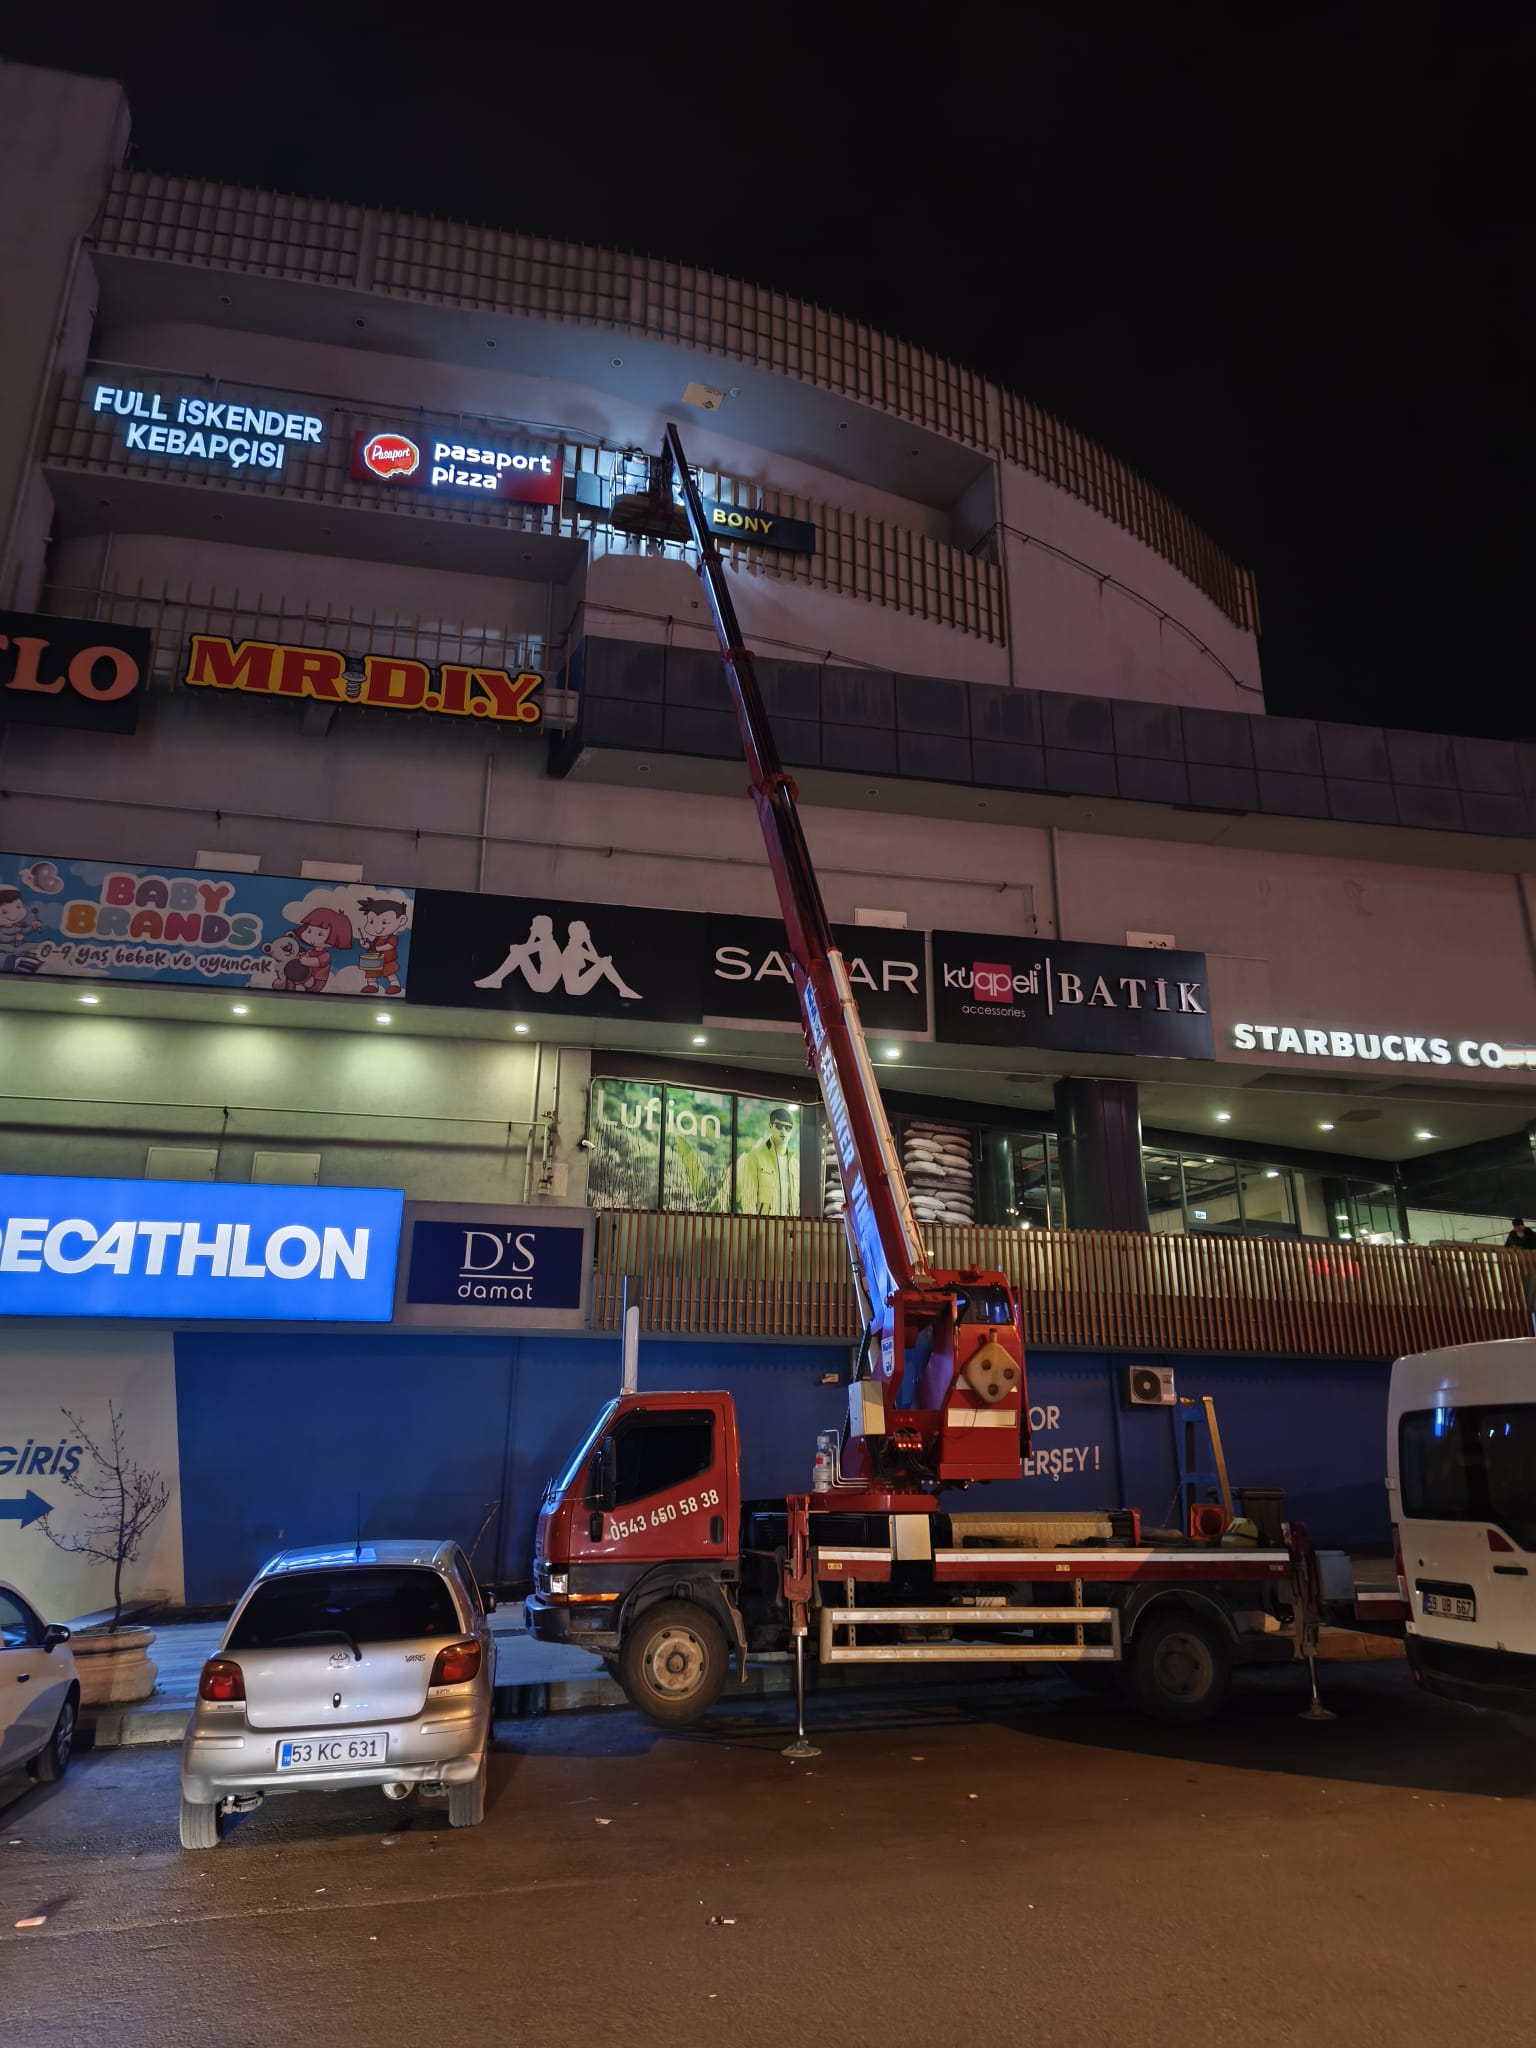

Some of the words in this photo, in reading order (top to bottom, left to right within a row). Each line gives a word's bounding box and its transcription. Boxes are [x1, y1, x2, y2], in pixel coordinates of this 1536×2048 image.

[93, 385, 168, 422] FULL
[176, 397, 324, 444] İSKENDER
[125, 422, 286, 470] KEBAPÇISI
[371, 443, 412, 463] Pasaport
[433, 442, 553, 474] pasaport
[431, 463, 498, 490] pizza
[712, 507, 774, 535] BONY
[103, 873, 231, 915] BABY
[63, 902, 259, 947] BRANDS
[41, 943, 73, 960] 0-9
[75, 947, 109, 966] yaş
[173, 952, 192, 966] ve
[713, 945, 920, 995] SAAR
[961, 1004, 1027, 1019] accessories
[1056, 971, 1208, 1015] BATİK
[1234, 1022, 1453, 1066] STARBUCKS
[596, 1088, 722, 1140] Lufian
[0, 1217, 371, 1281] ECATHLON
[459, 1230, 537, 1273] D'S
[457, 1281, 534, 1301] damat
[1020, 1446, 1089, 1483] ERŞEY
[609, 1514, 648, 1542] 0543
[650, 1503, 678, 1527] 650
[679, 1496, 699, 1516] 58
[700, 1488, 720, 1508] 38
[1456, 1599, 1472, 1616] 667
[292, 1745, 313, 1763] 53
[317, 1742, 343, 1761] KC
[348, 1739, 378, 1759] 631
